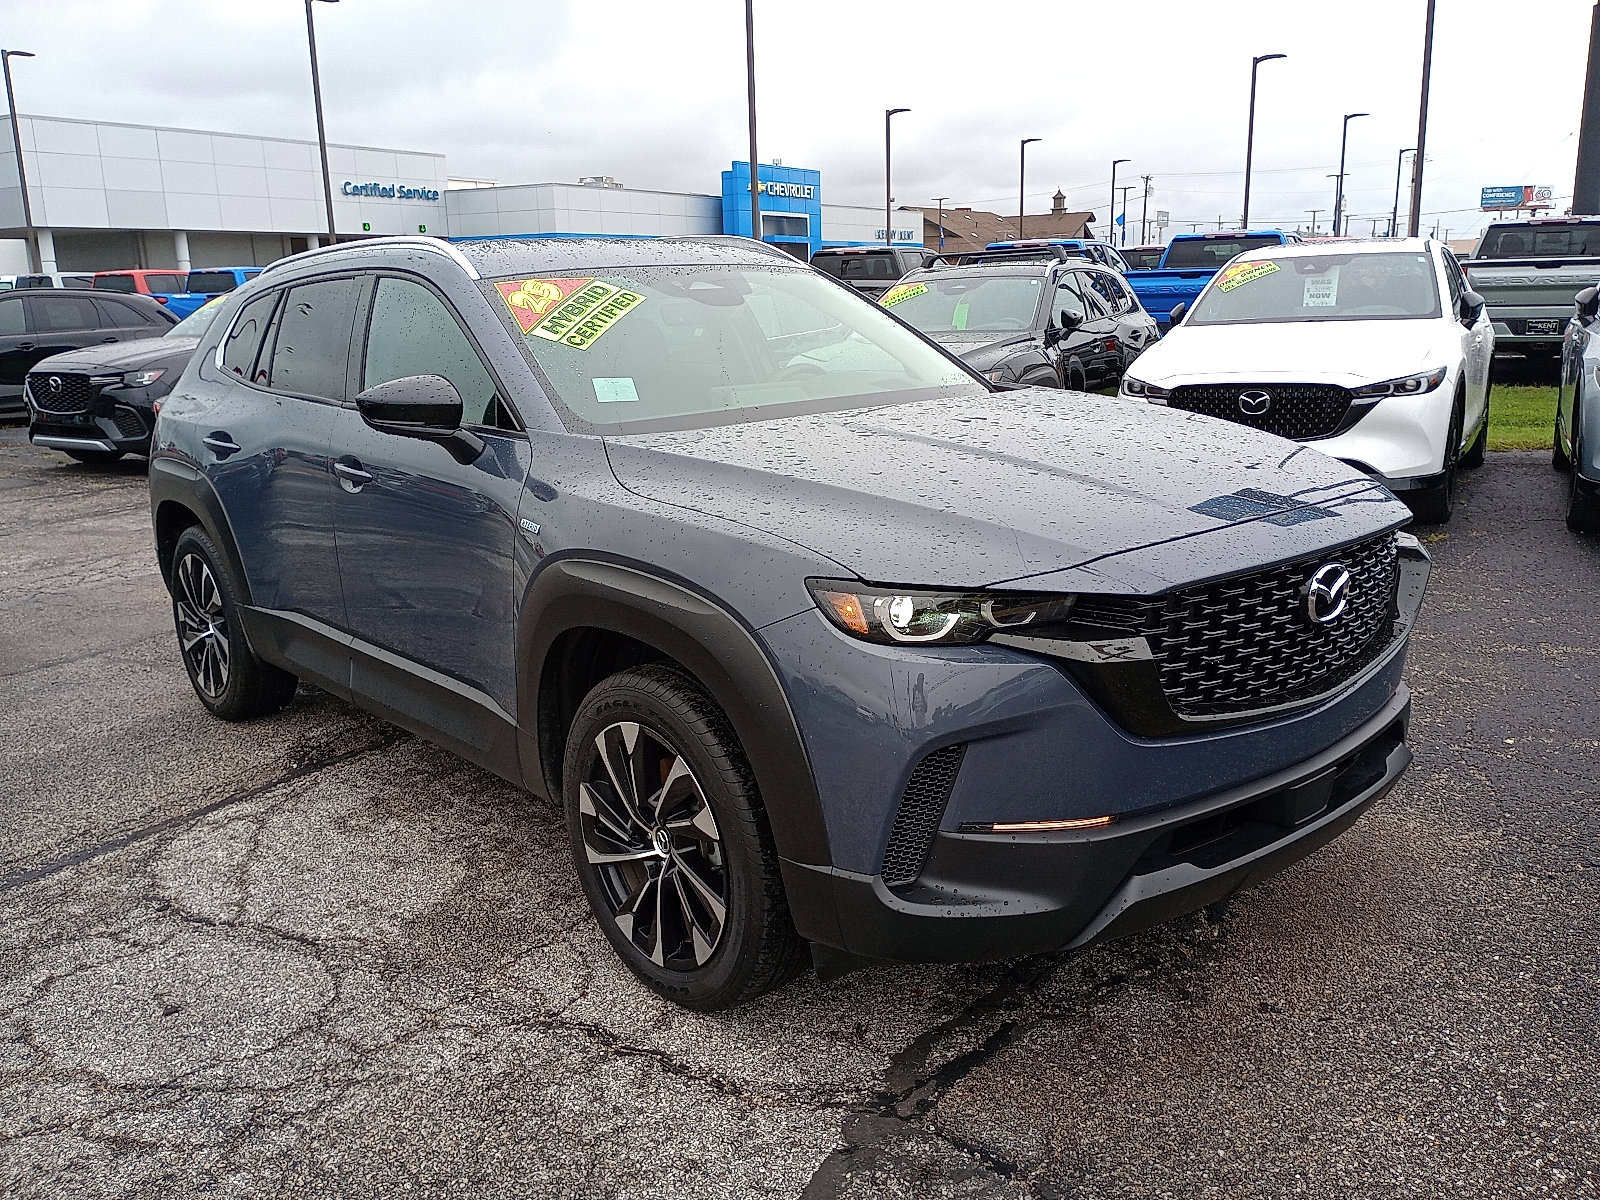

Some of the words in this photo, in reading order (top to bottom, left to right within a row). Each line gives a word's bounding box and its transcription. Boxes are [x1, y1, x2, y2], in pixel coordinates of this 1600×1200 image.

[343, 181, 396, 198] Certified
[398, 185, 439, 200] Service
[767, 181, 815, 198] CHEVROLET
[875, 229, 897, 240] KEY
[1219, 277, 1236, 288] ONE
[1240, 262, 1273, 278] OWNER
[1133, 285, 1202, 294] CHEVR
[541, 285, 613, 335] HYBRID
[566, 291, 639, 347] CERTIFIED
